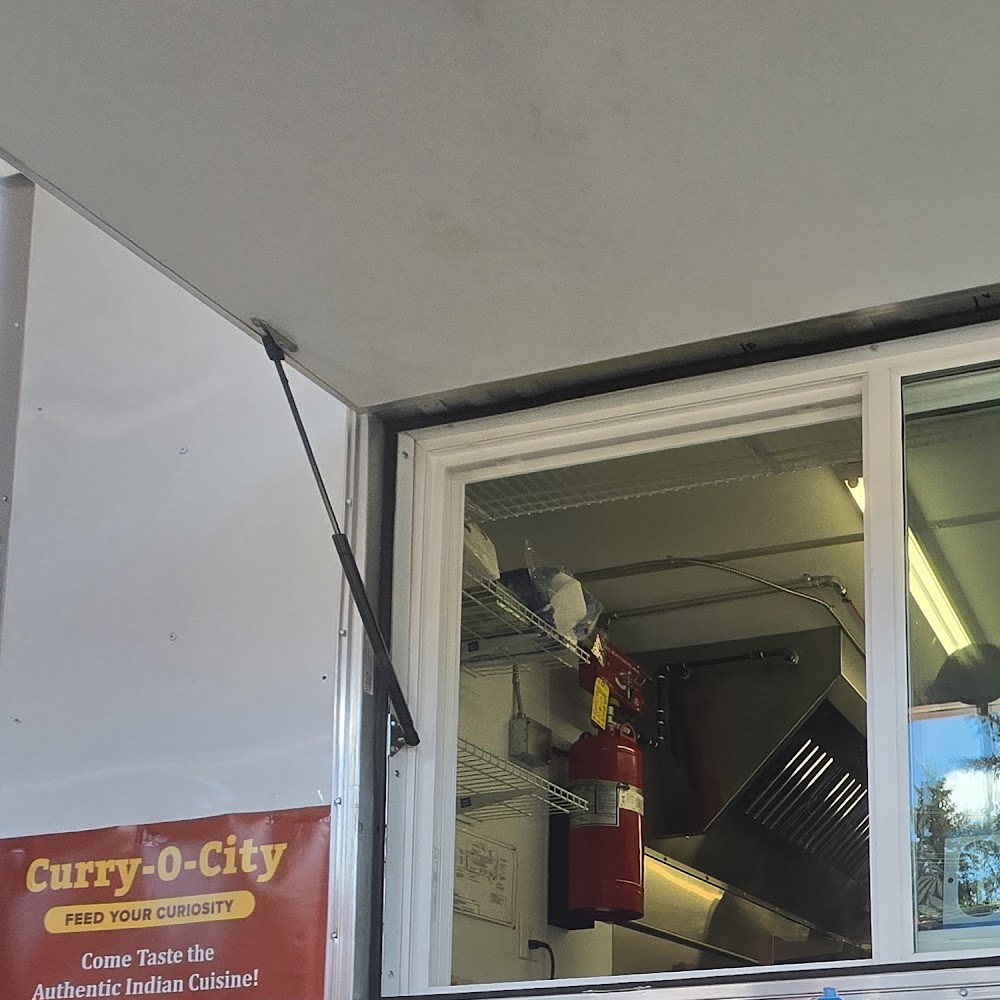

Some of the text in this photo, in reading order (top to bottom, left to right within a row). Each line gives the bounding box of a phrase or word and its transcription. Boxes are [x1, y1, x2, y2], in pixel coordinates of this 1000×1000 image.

[26, 834, 288, 897] Curry-O-City
[65, 899, 235, 926] FEED YOUR CURIOSITY
[81, 944, 214, 970] Come Taste the
[32, 969, 259, 1000] Authentic Indian Cuisine!
